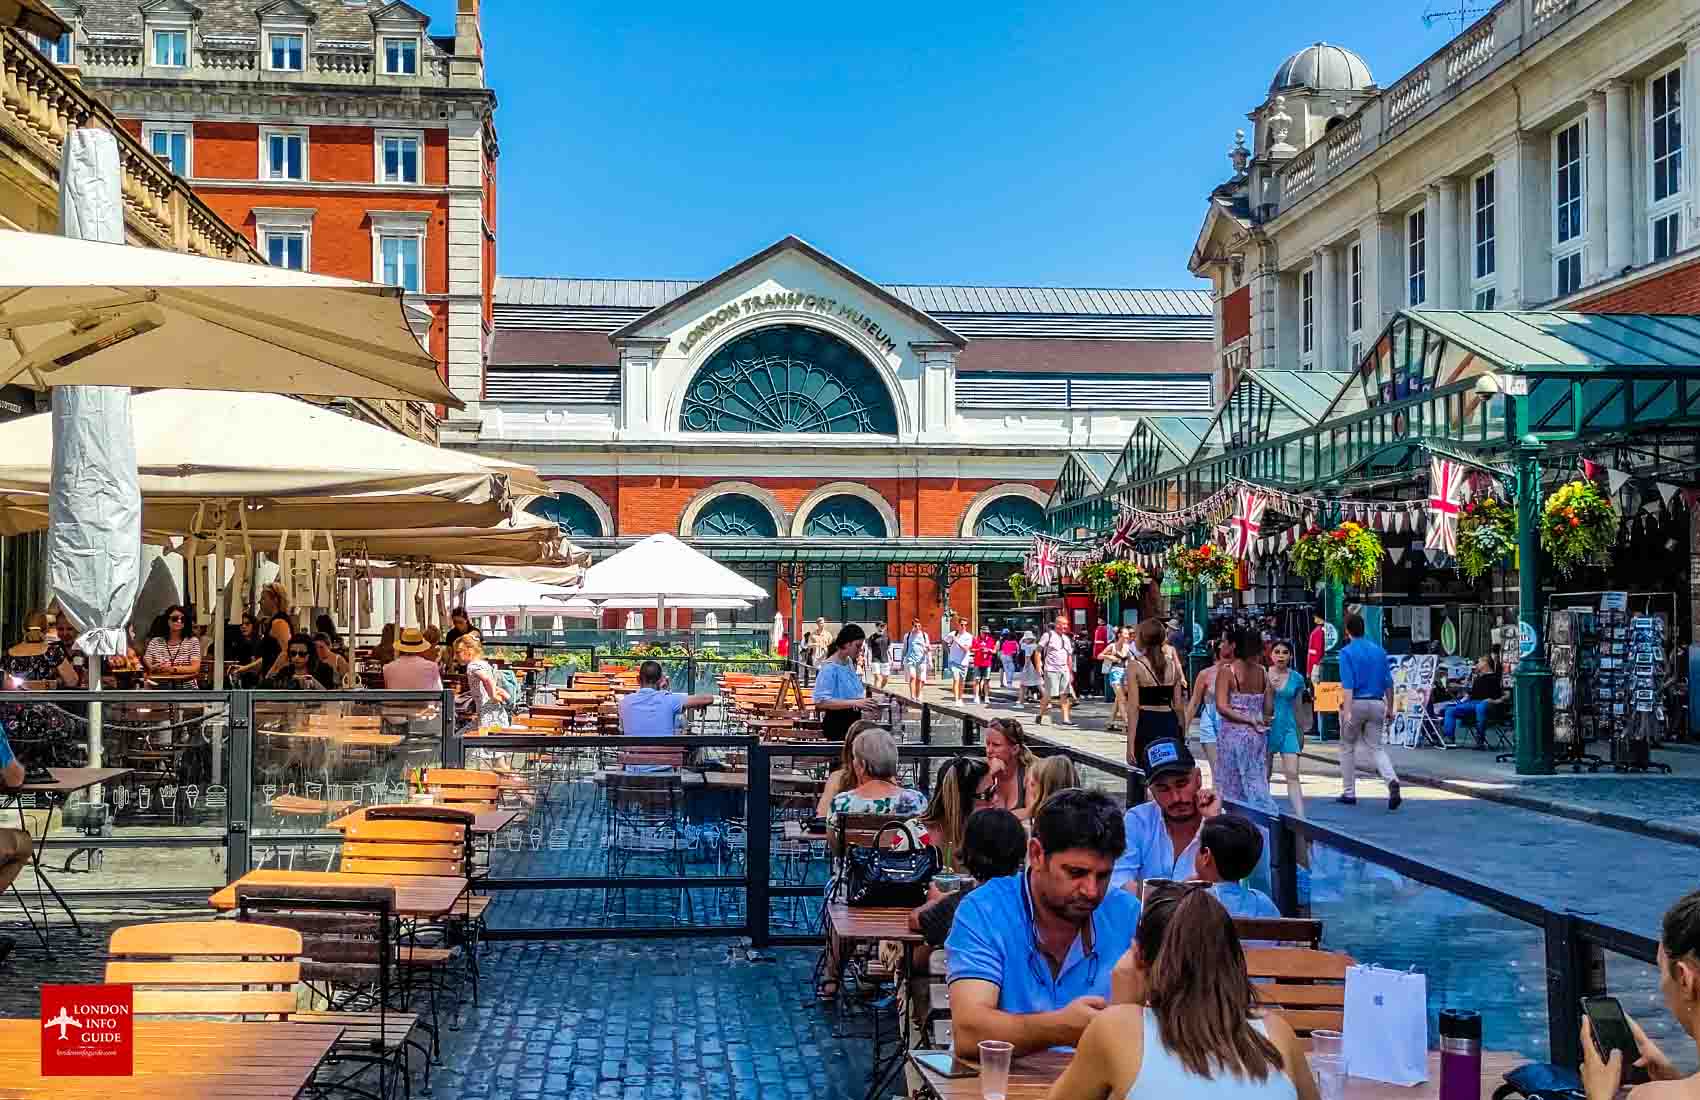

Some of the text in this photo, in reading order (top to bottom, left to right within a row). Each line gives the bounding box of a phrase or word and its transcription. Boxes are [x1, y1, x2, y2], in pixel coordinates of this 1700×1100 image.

[679, 292, 897, 354] LONDON TRANSPORT MUSEUM
